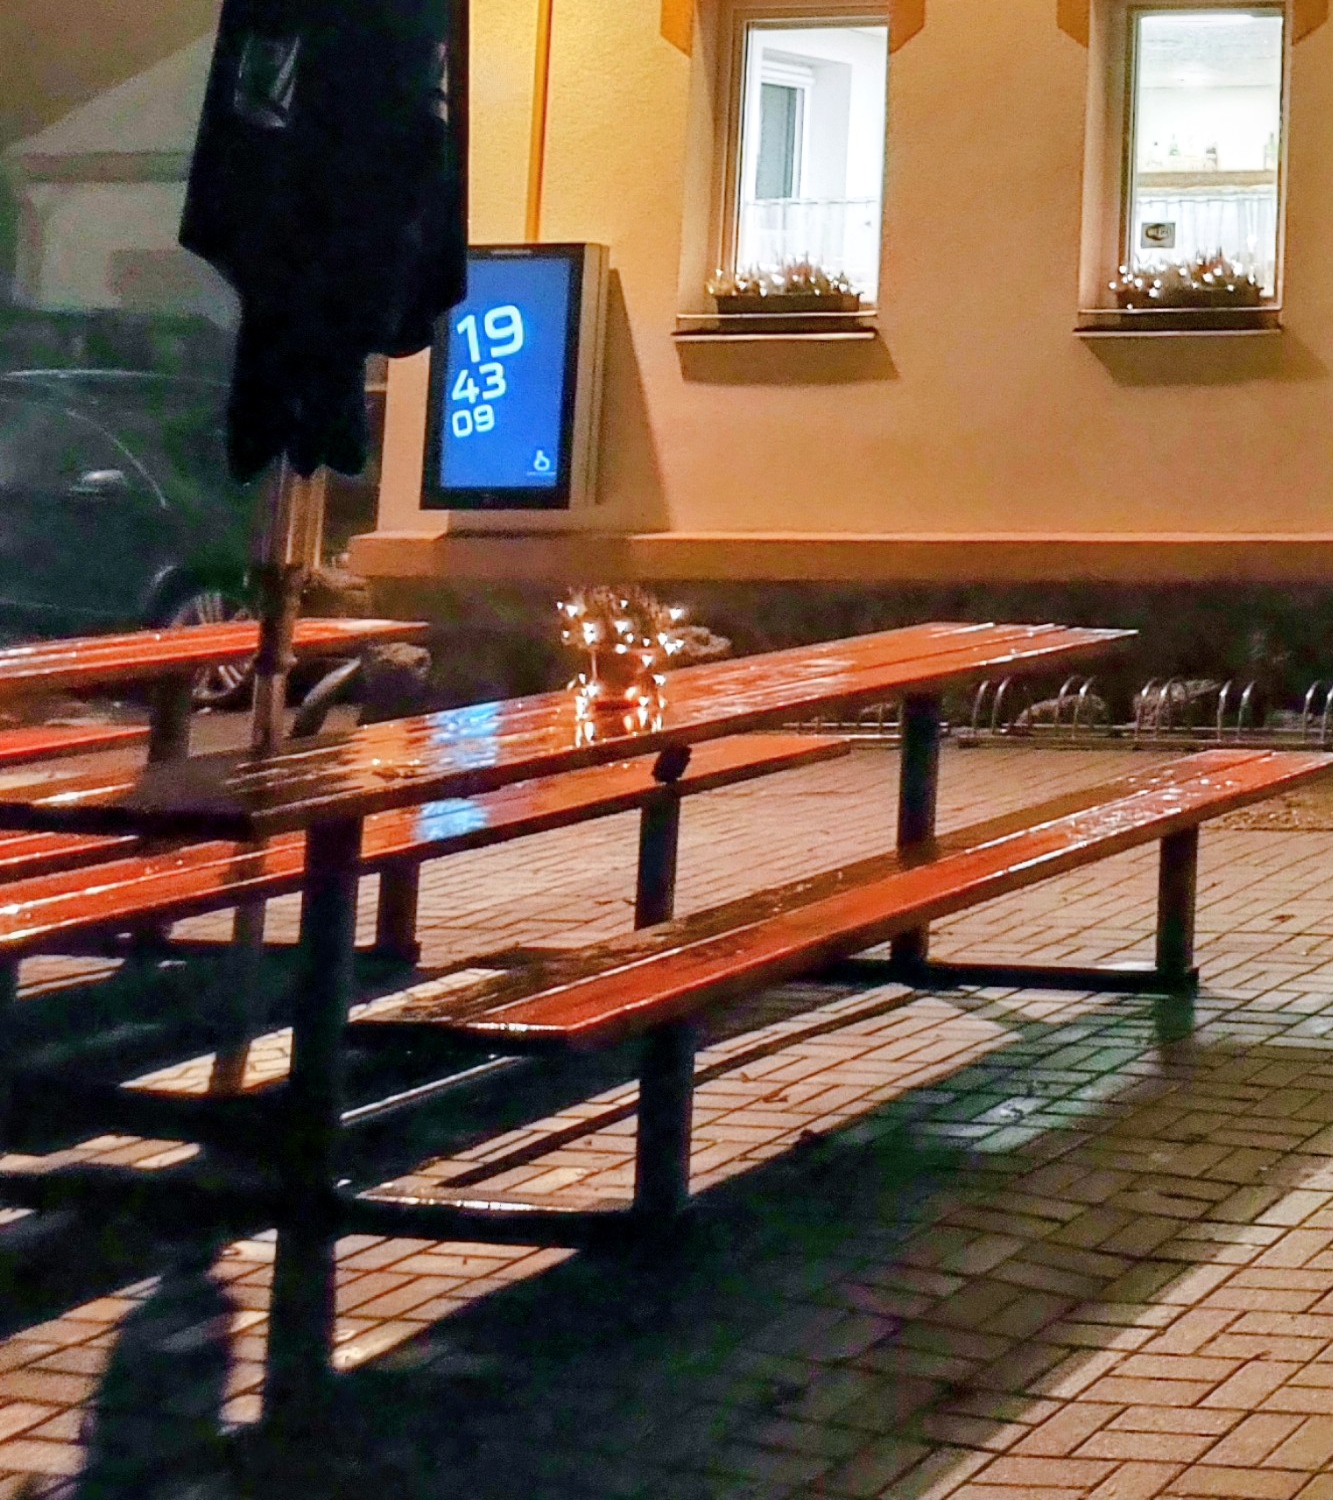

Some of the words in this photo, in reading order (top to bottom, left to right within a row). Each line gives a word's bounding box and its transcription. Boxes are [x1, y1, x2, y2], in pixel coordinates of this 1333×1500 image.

[456, 304, 525, 363] 19
[451, 361, 507, 404] 43
[451, 403, 495, 438] 09
